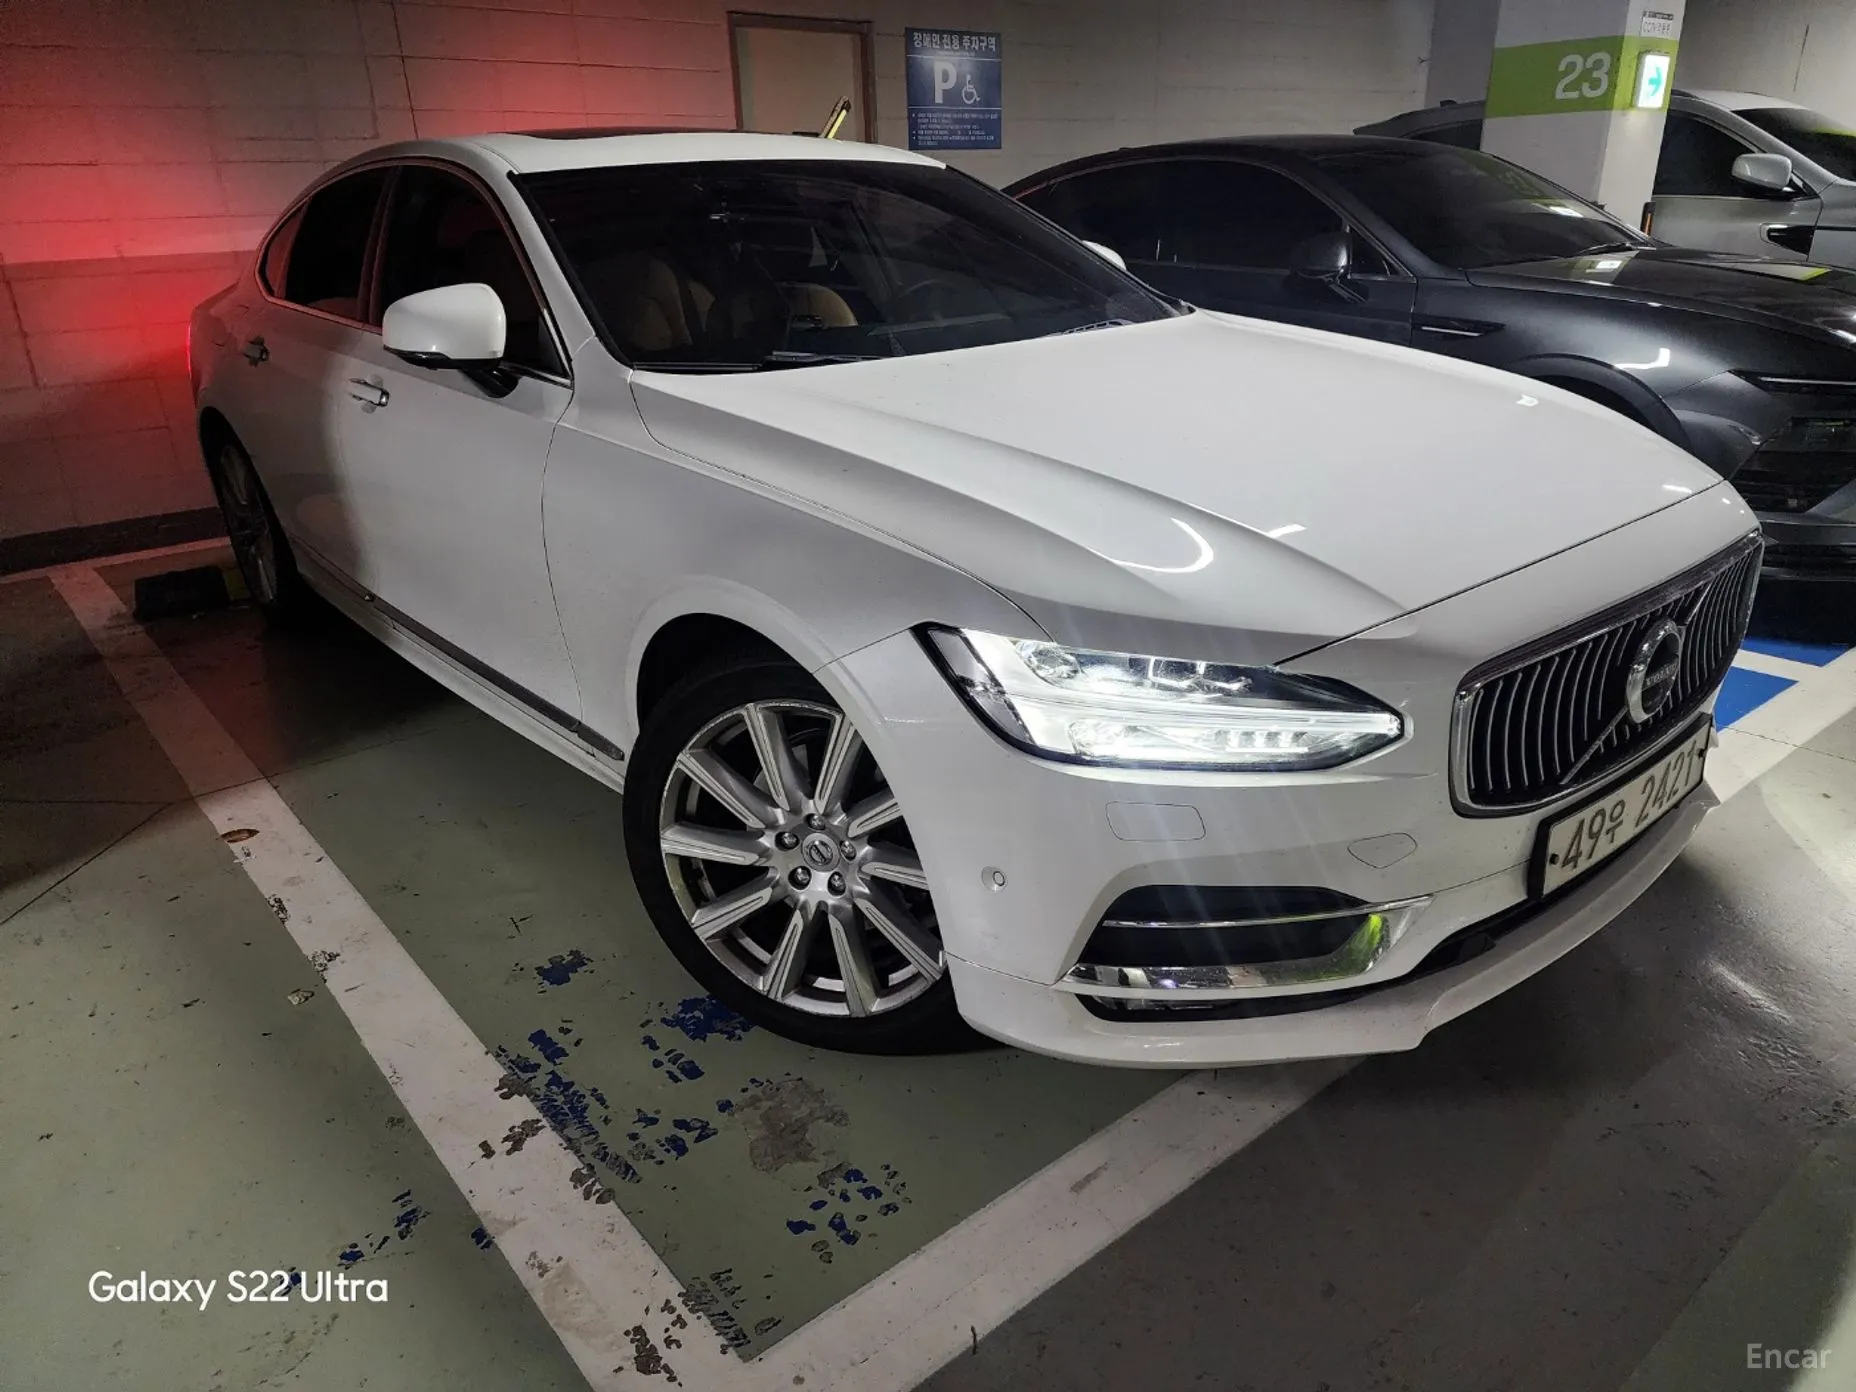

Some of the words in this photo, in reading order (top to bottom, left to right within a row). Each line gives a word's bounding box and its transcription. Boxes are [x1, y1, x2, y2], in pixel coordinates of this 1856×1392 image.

[913, 31, 940, 49] 장애인
[942, 34, 960, 50] 전용
[962, 35, 996, 52] 주차구역
[933, 61, 957, 104] P
[1555, 51, 1611, 100] 23
[1560, 799, 1625, 870] 49우
[1635, 739, 1698, 829] 2421
